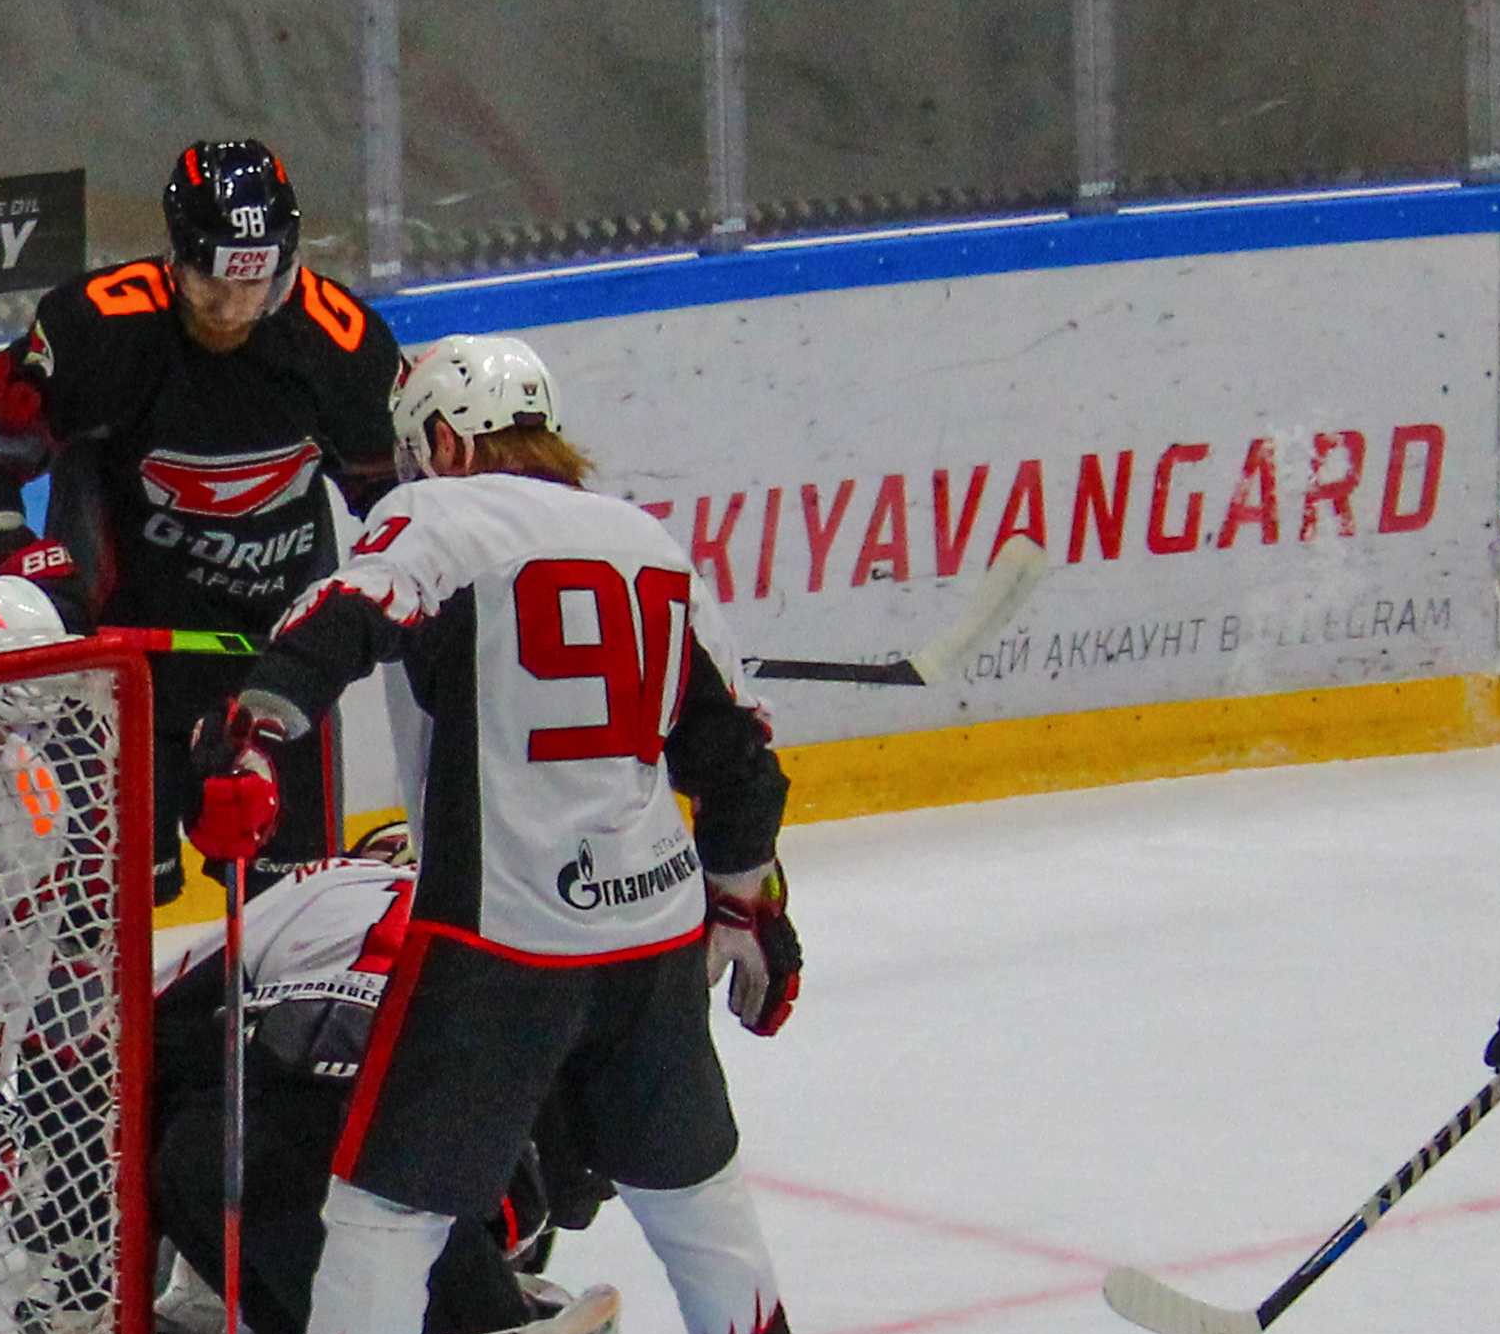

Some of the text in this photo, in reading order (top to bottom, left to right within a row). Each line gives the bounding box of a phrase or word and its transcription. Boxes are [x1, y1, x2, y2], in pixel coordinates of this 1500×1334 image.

[9, 200, 40, 217] OIL
[231, 205, 268, 239] 98
[224, 264, 267, 278] BET
[228, 250, 268, 264] FON
[640, 424, 1447, 604] KIYAVANGARD
[143, 513, 315, 574] G-DRIVE
[513, 559, 692, 766] 90
[1045, 618, 1205, 668] АККАУНТ
